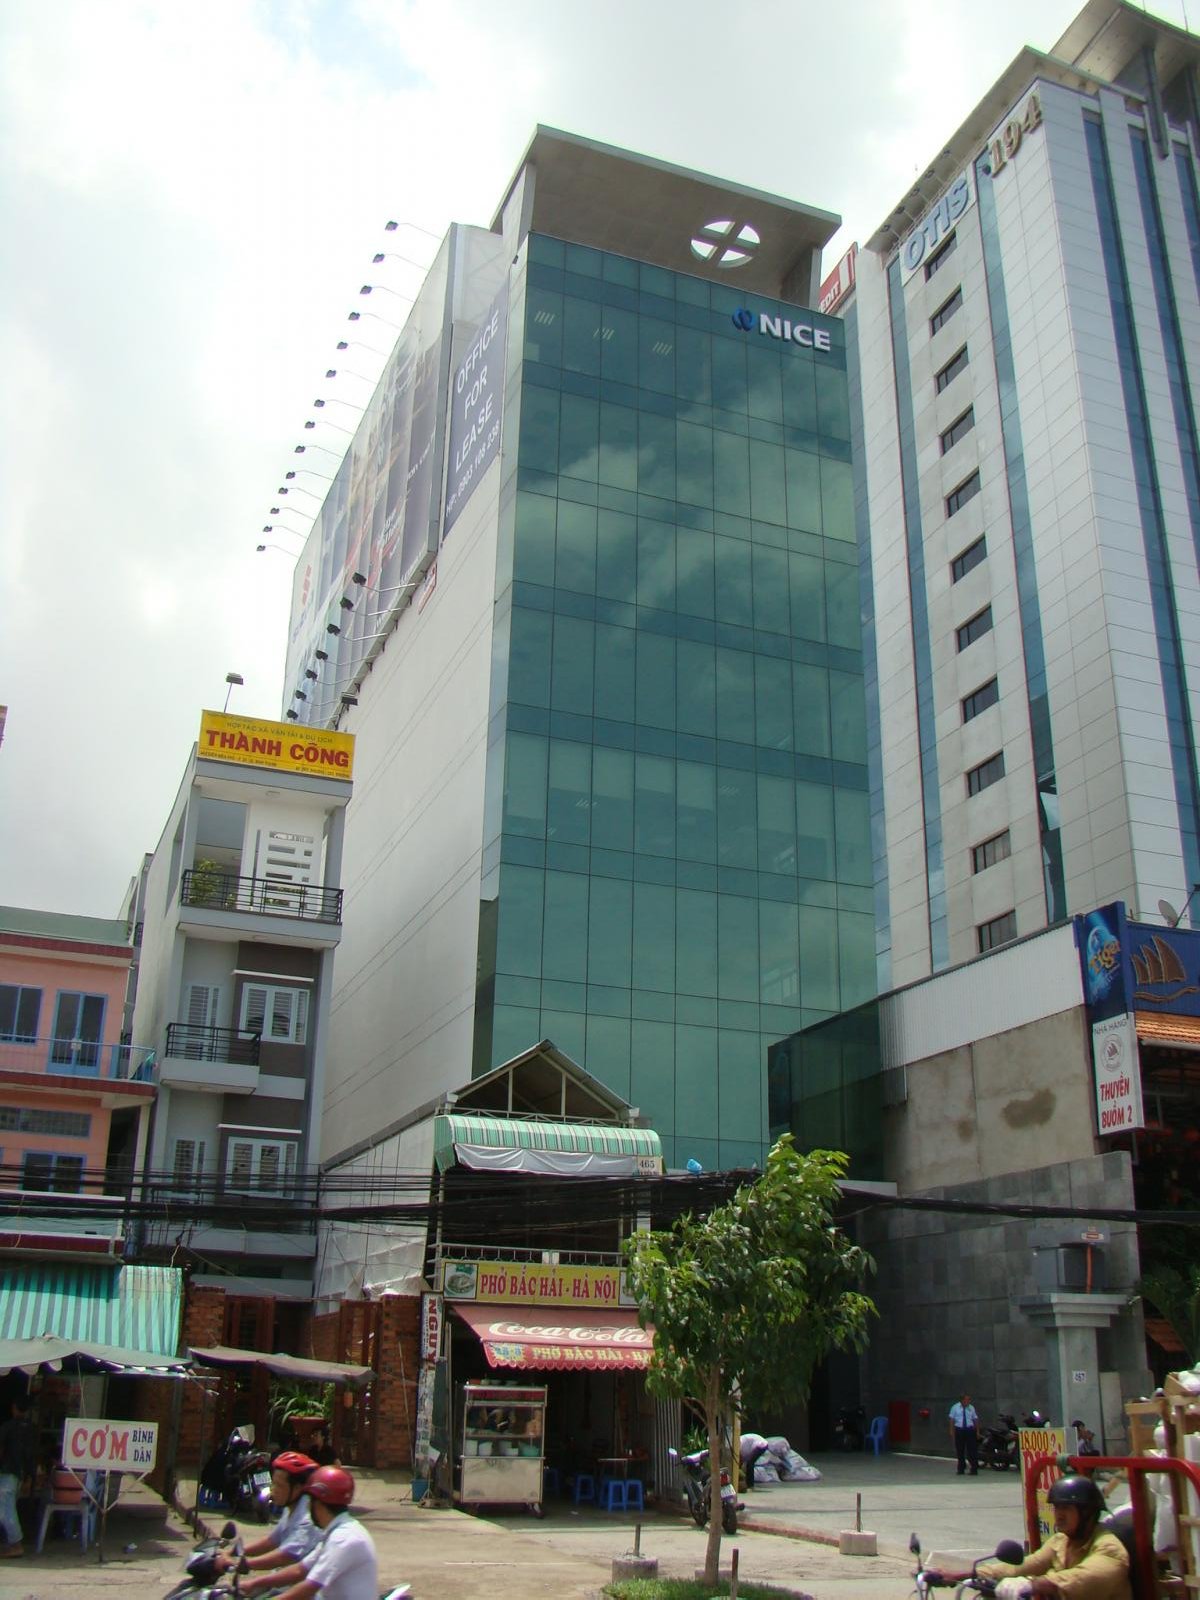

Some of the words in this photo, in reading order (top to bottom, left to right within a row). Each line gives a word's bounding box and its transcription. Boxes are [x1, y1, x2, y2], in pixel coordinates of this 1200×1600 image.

[990, 95, 1042, 178] 194
[904, 177, 969, 270] OTIS
[457, 309, 499, 394] OFFICE
[760, 313, 831, 352] NICE
[464, 365, 488, 420] FOR
[456, 393, 493, 473] LEASE
[206, 730, 282, 756] THÀNH
[290, 742, 349, 768] CÔNG
[1127, 1104, 1133, 1123] 2
[640, 1159, 655, 1169] 465
[480, 1266, 507, 1295] PHỞ
[510, 1264, 537, 1296] BẮC
[573, 1273, 590, 1298] HÀ
[594, 1273, 617, 1303] NỘI
[489, 1322, 648, 1343] Coca-Cola
[71, 1424, 130, 1461] CƠM
[132, 1427, 154, 1443] BÌNH
